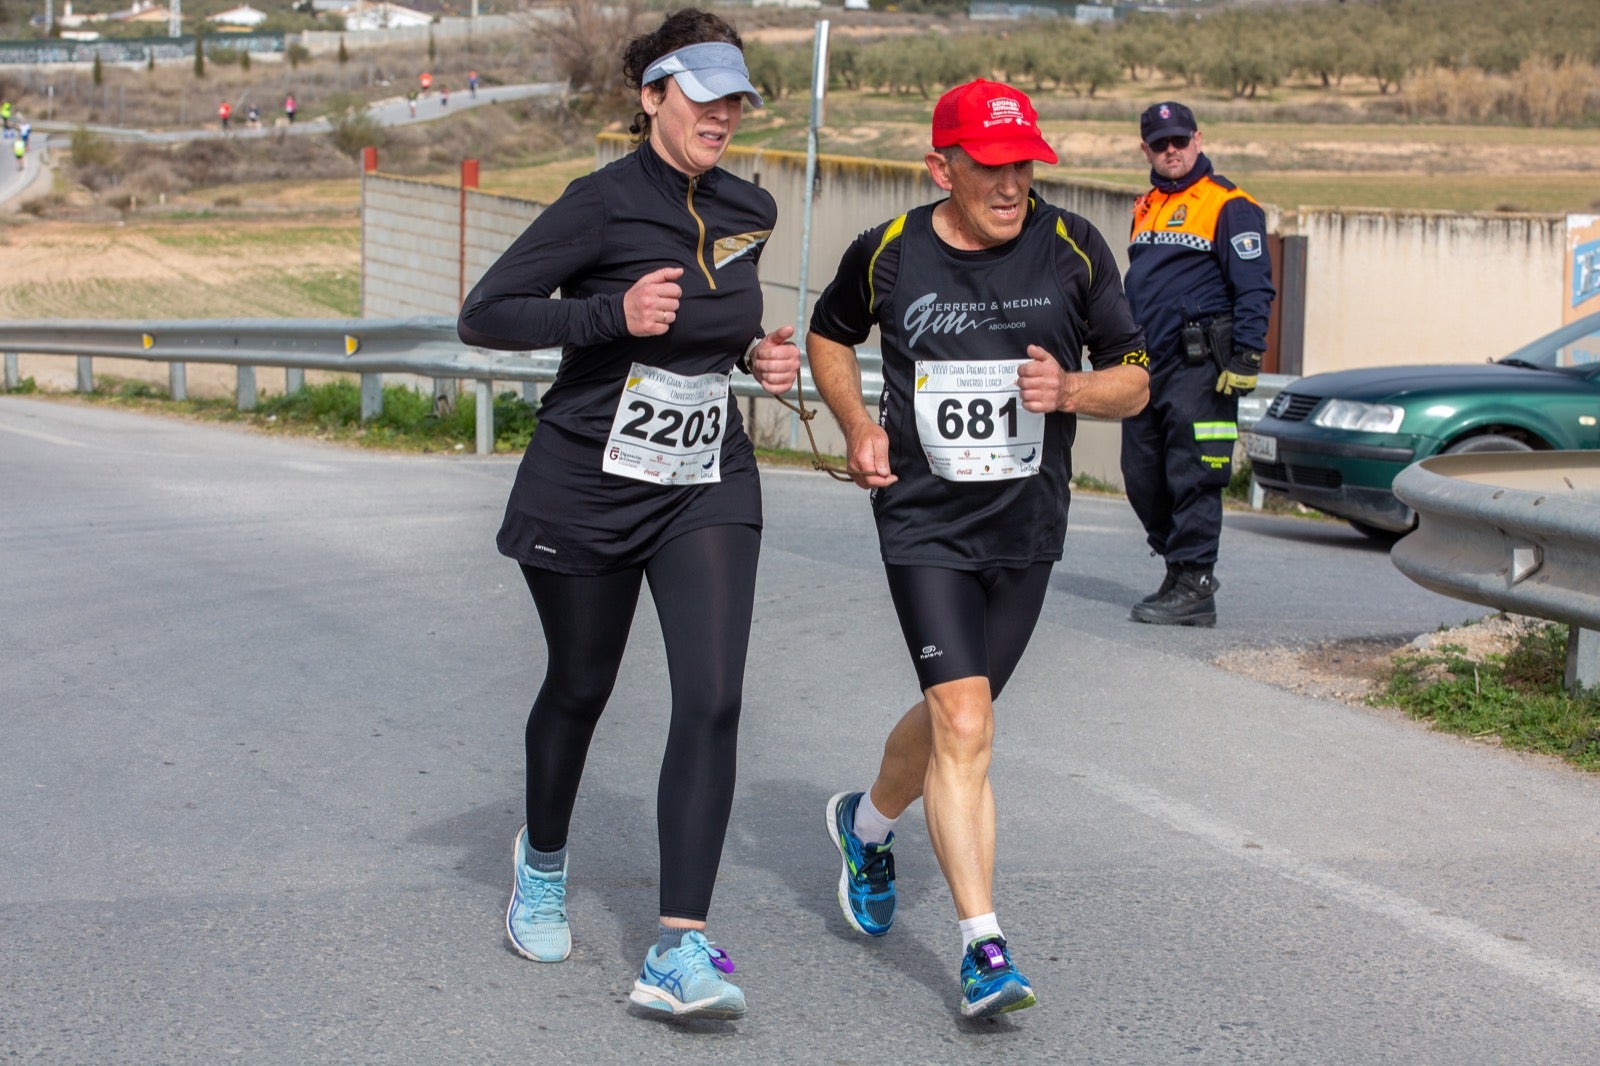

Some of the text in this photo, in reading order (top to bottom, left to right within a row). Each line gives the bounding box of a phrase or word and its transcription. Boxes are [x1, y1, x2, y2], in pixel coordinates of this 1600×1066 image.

[918, 297, 1051, 312] GUERRERO & MEDINA
[988, 321, 1027, 331] ABOGADOS
[619, 400, 721, 448] 2203
[936, 397, 1018, 440] 681
